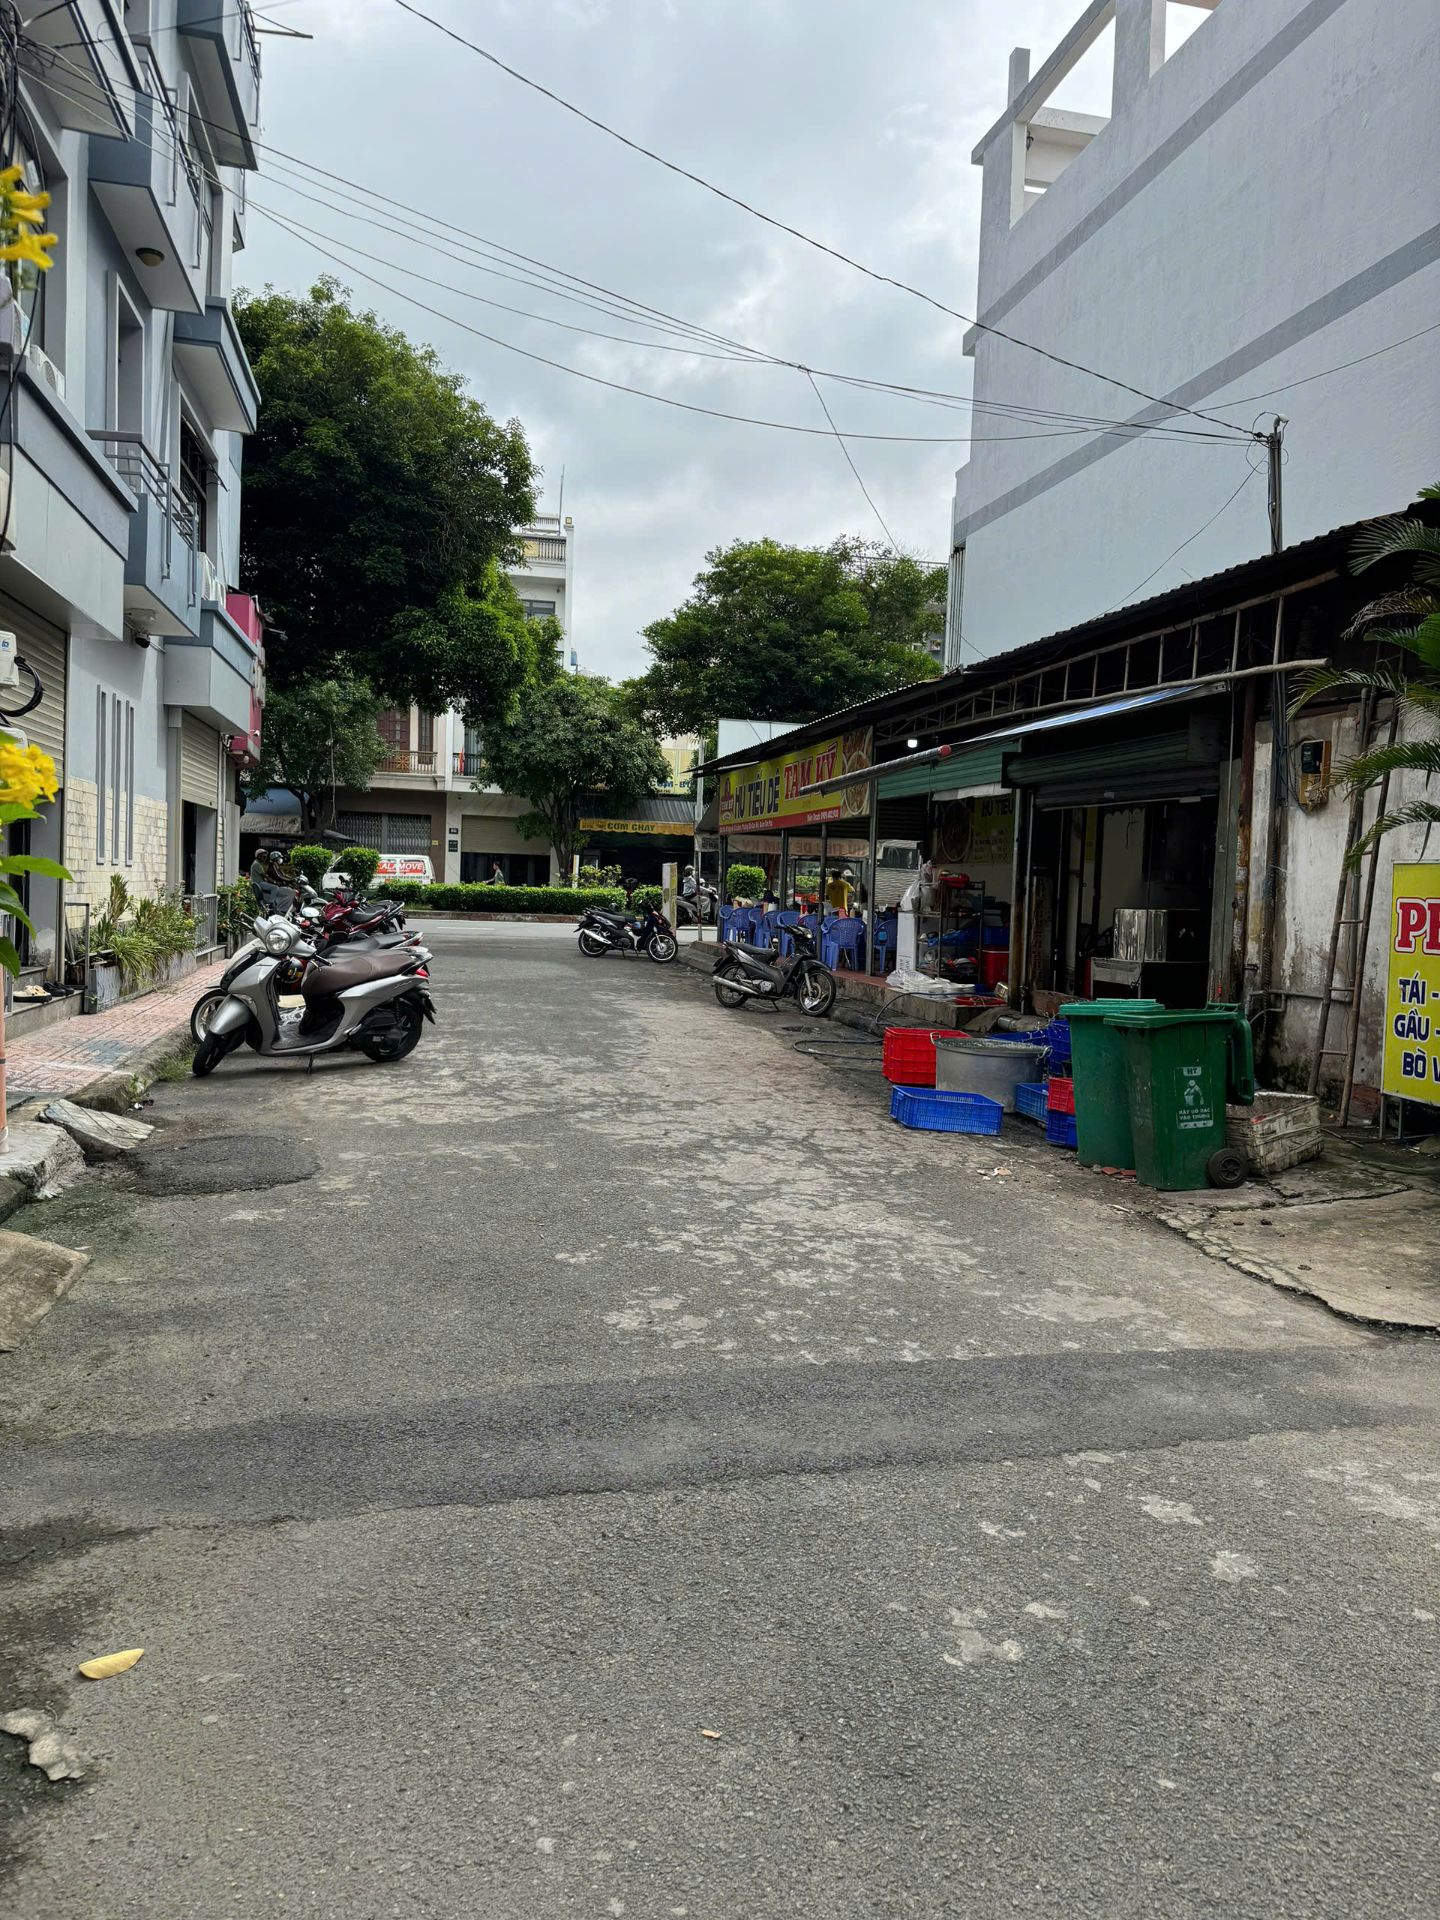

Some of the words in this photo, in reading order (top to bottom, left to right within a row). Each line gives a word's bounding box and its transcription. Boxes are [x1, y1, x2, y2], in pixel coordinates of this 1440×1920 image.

[1399, 971, 1426, 1005] TÁI
[1393, 1008, 1430, 1041] GẦU
[1402, 1048, 1426, 1079] BÒ
